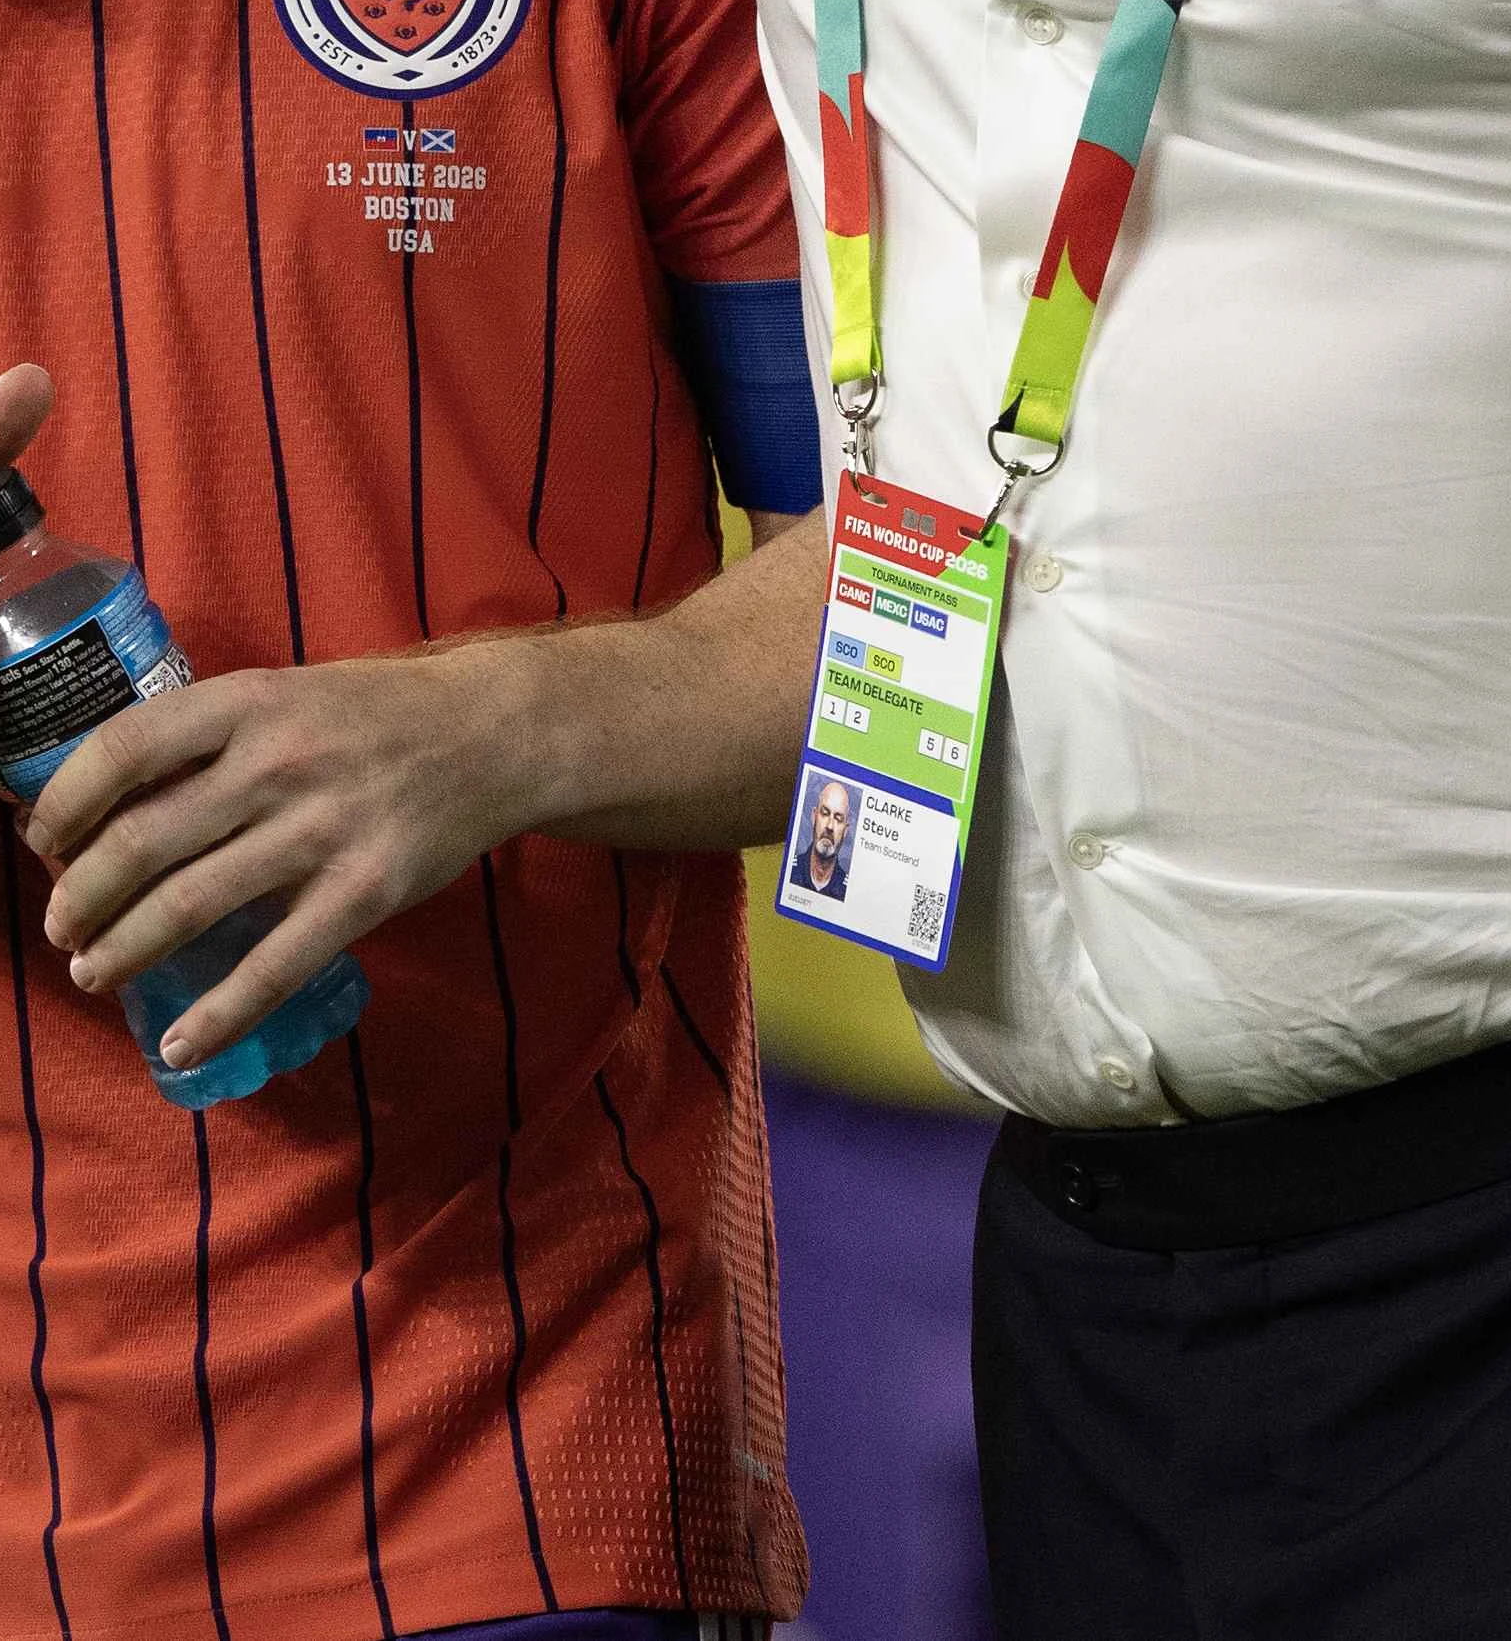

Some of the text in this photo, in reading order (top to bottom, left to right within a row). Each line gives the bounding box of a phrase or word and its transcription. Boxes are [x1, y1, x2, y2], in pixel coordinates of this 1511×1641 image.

[319, 38, 353, 67] EST
[458, 31, 495, 64] 1873
[403, 130, 416, 151] V
[326, 162, 487, 190] 13 JUNE 2026
[364, 195, 455, 222] BOSTON
[387, 229, 434, 253] USA
[844, 515, 989, 581] FIFA WORLD CUP 2026
[871, 567, 958, 608] TOURNAMENT PASS
[839, 583, 945, 632] CANC MEXC USAC
[835, 640, 895, 672] SCO SCO
[828, 669, 924, 716] TEAM DELEGATE
[830, 702, 862, 724] 1 2
[926, 737, 959, 760] 5 6
[866, 796, 912, 823] CLARKE
[862, 817, 899, 841] Steve
[860, 837, 920, 867] Team Scotland
